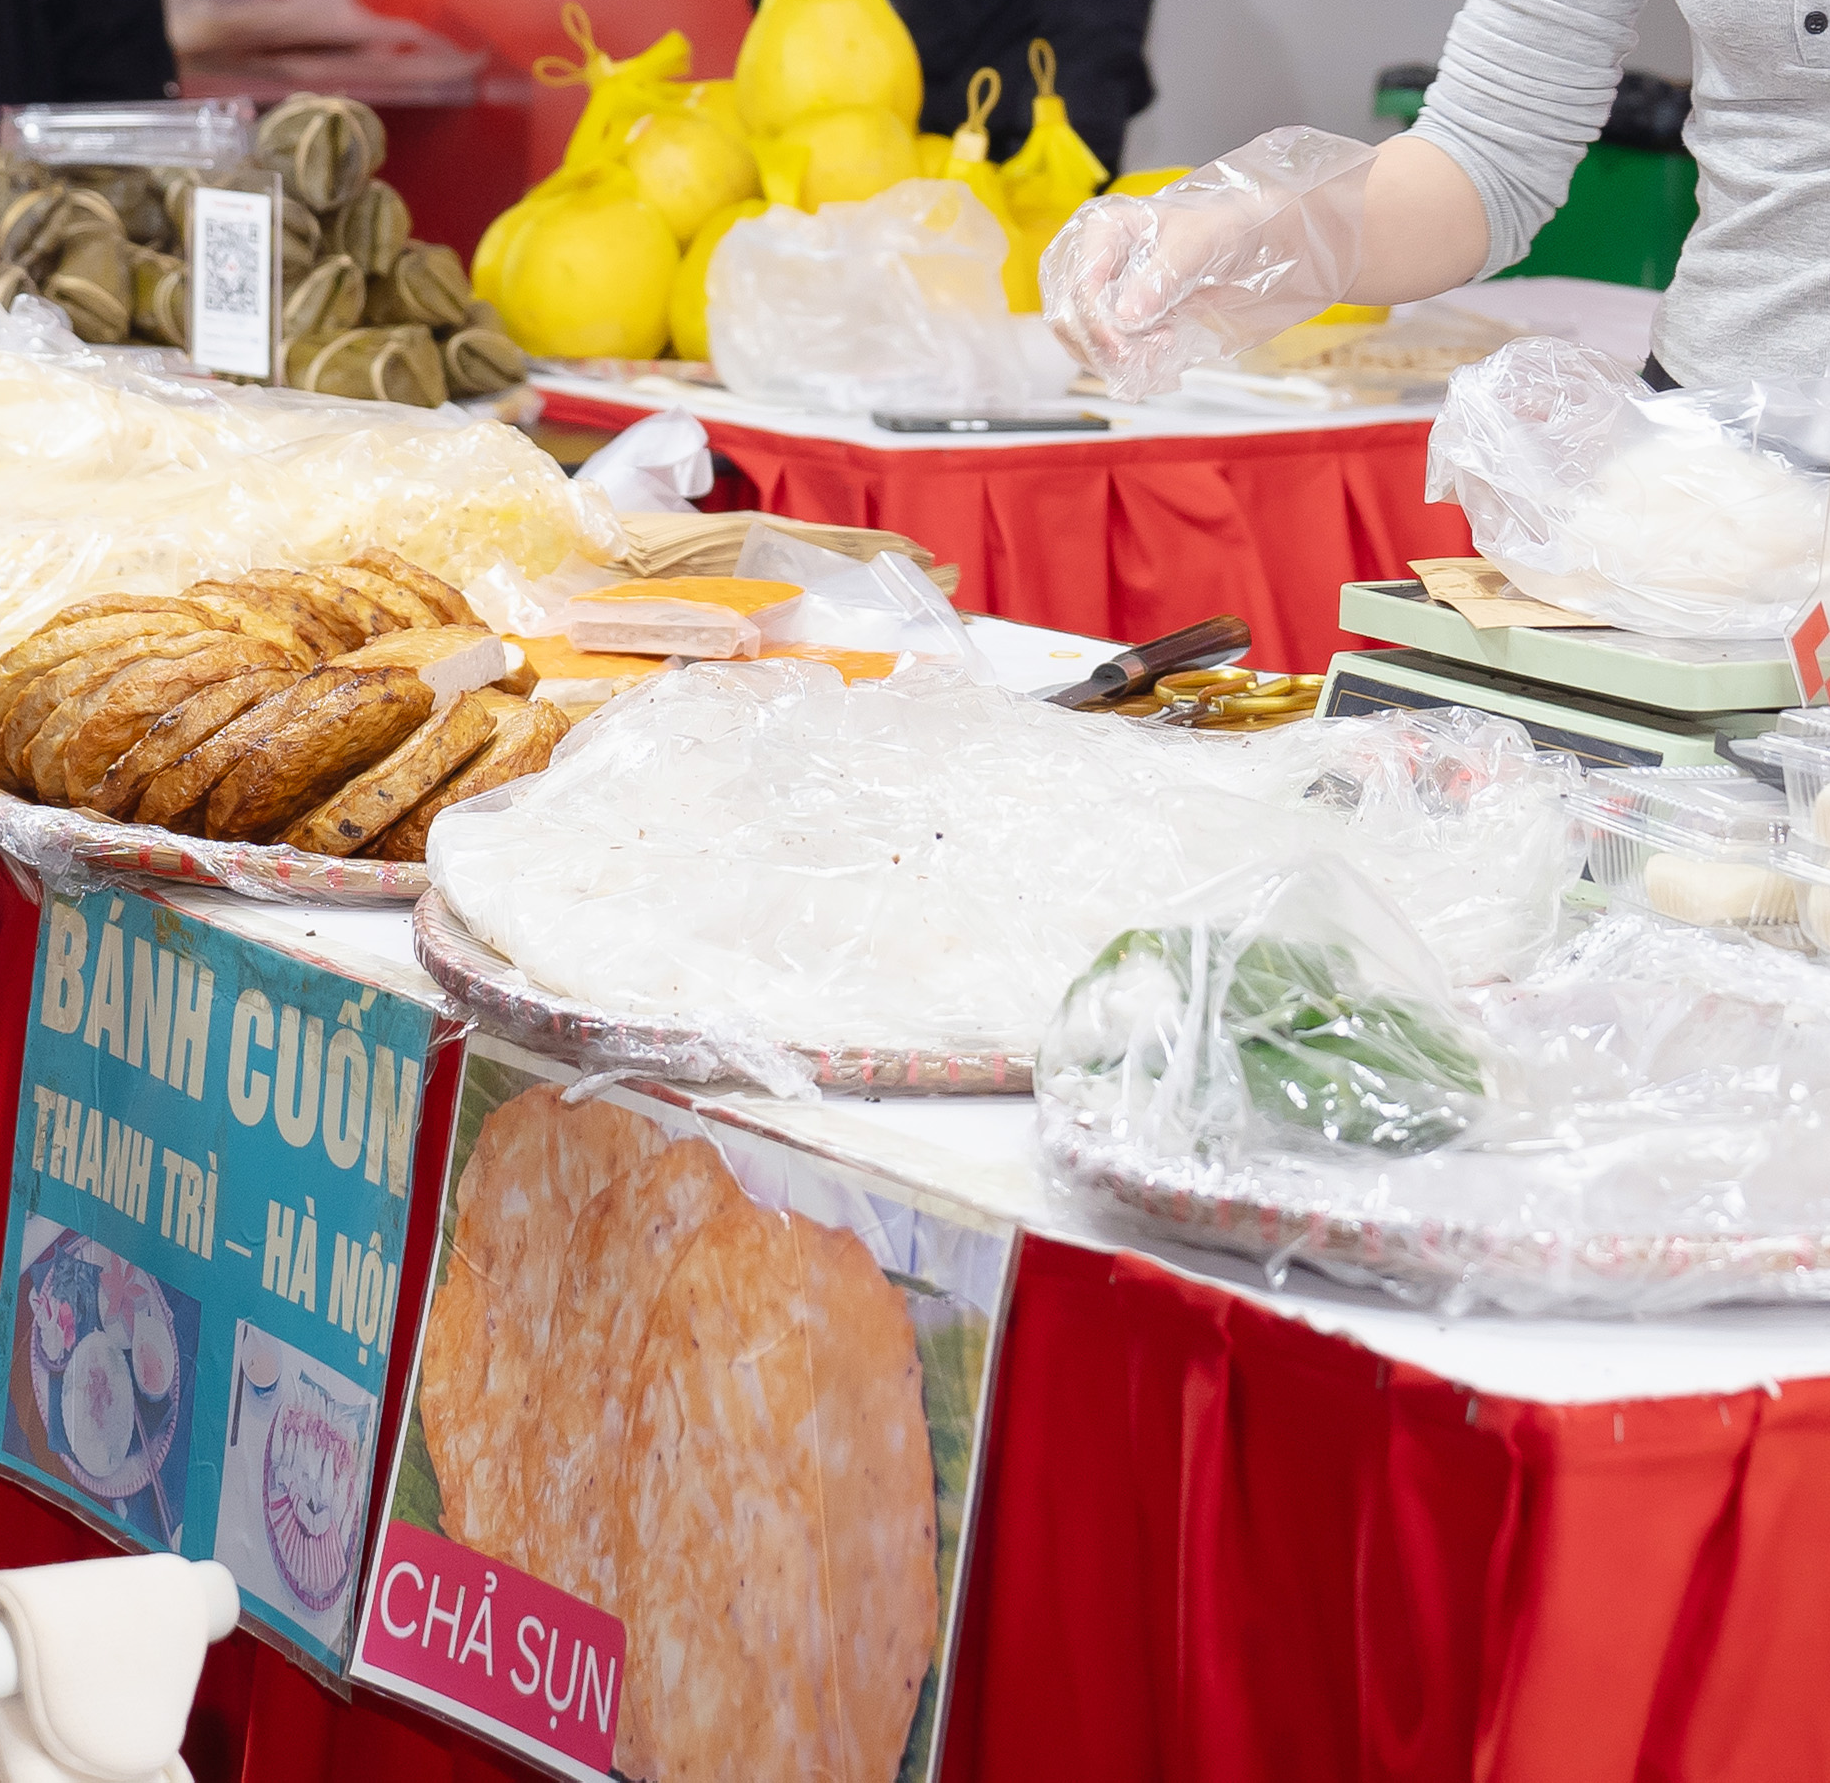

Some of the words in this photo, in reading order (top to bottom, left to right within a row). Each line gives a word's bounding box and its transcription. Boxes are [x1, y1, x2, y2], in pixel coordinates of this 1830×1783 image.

[40, 900, 216, 1101] BÁNH
[227, 989, 421, 1199] CUỐN
[31, 1085, 155, 1225] THANH
[160, 1147, 219, 1261] TRÌ
[262, 1195, 318, 1314] HÀ
[327, 1230, 397, 1366] NỘI
[378, 1561, 496, 1679] CHẢ
[510, 1615, 617, 1735] SỤN
